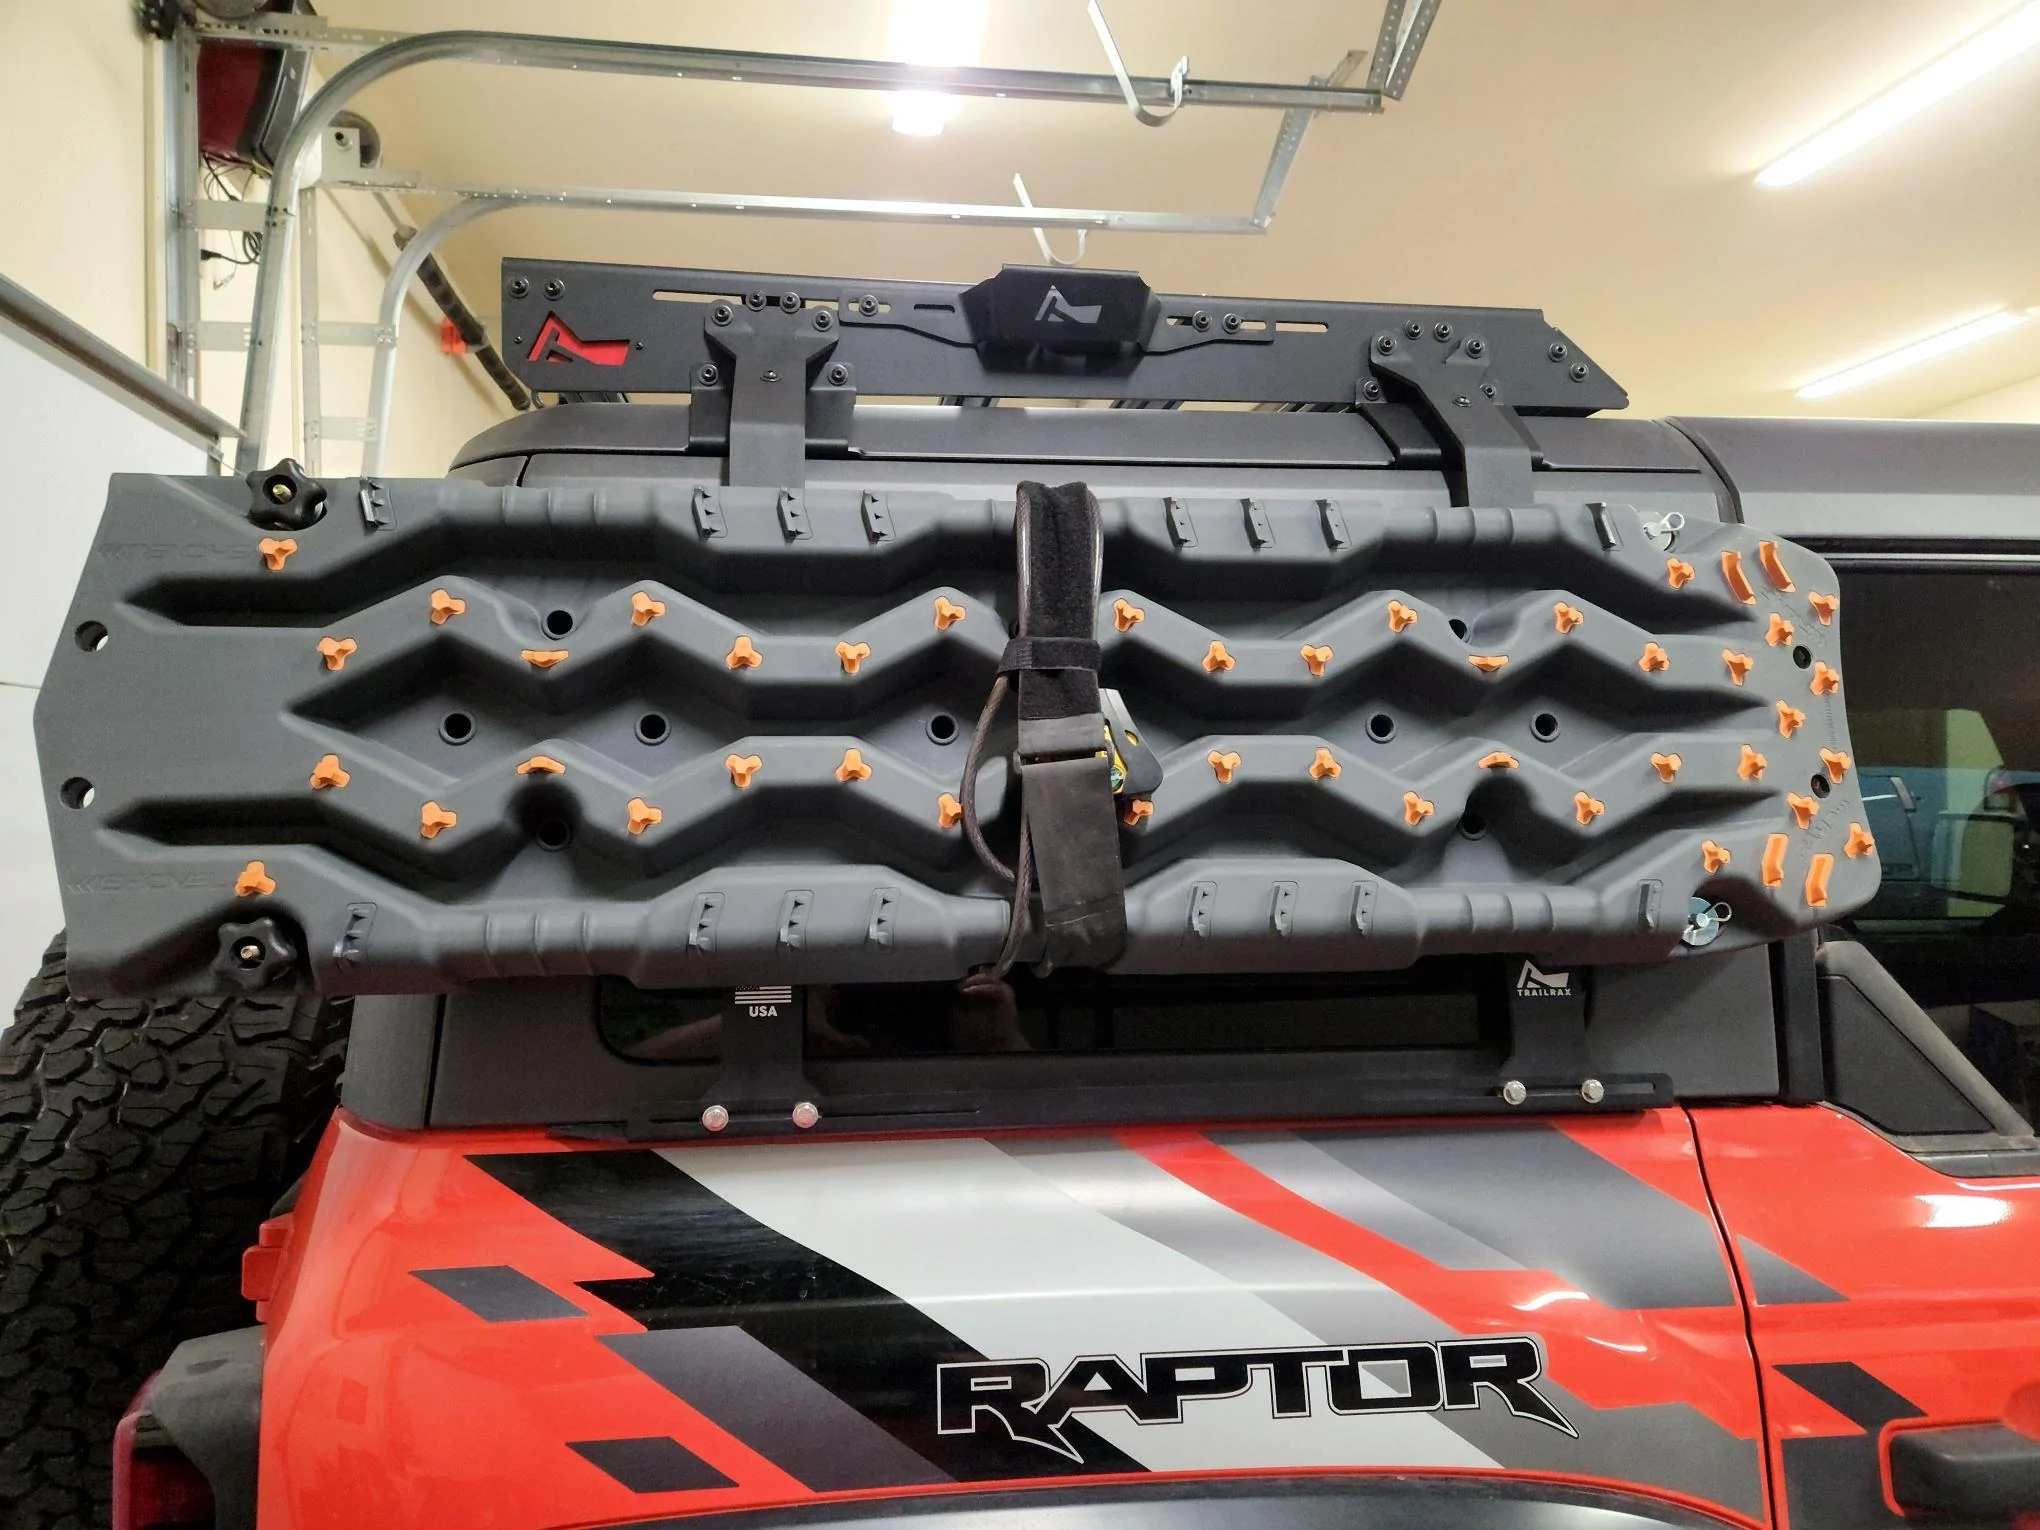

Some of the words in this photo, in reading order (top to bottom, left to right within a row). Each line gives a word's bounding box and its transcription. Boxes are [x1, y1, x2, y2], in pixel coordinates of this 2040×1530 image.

[1517, 988, 1571, 997] TRAILRAX
[749, 1005, 778, 1018] USA
[936, 1336, 1580, 1464] RAPTOR
